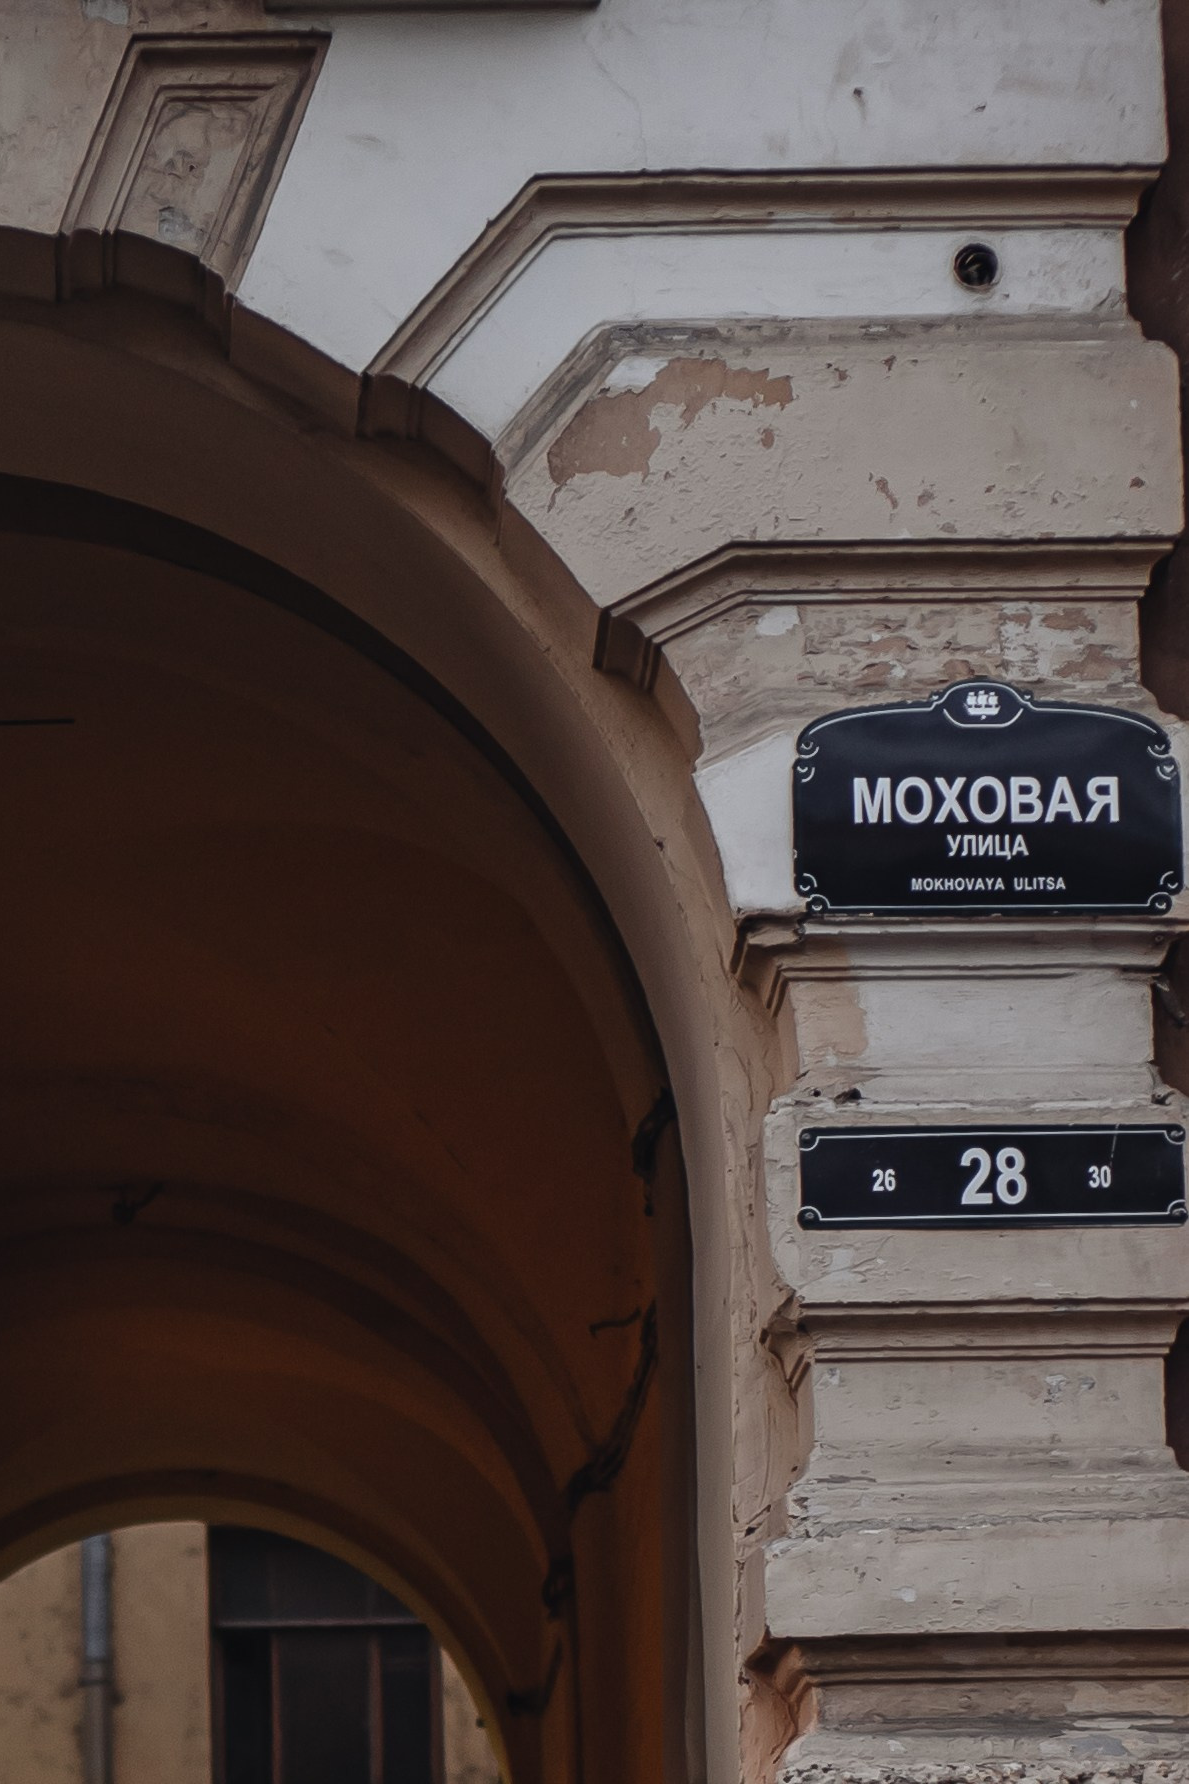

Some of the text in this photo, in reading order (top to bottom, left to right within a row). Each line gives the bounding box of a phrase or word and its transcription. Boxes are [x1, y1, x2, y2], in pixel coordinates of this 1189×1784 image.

[852, 775, 1121, 824] МОХОВАЯ
[946, 834, 1030, 860] УЛИЦА
[910, 876, 1067, 892] MOKHOVAYA ULITSA
[872, 1146, 1112, 1205] 26 28 30
